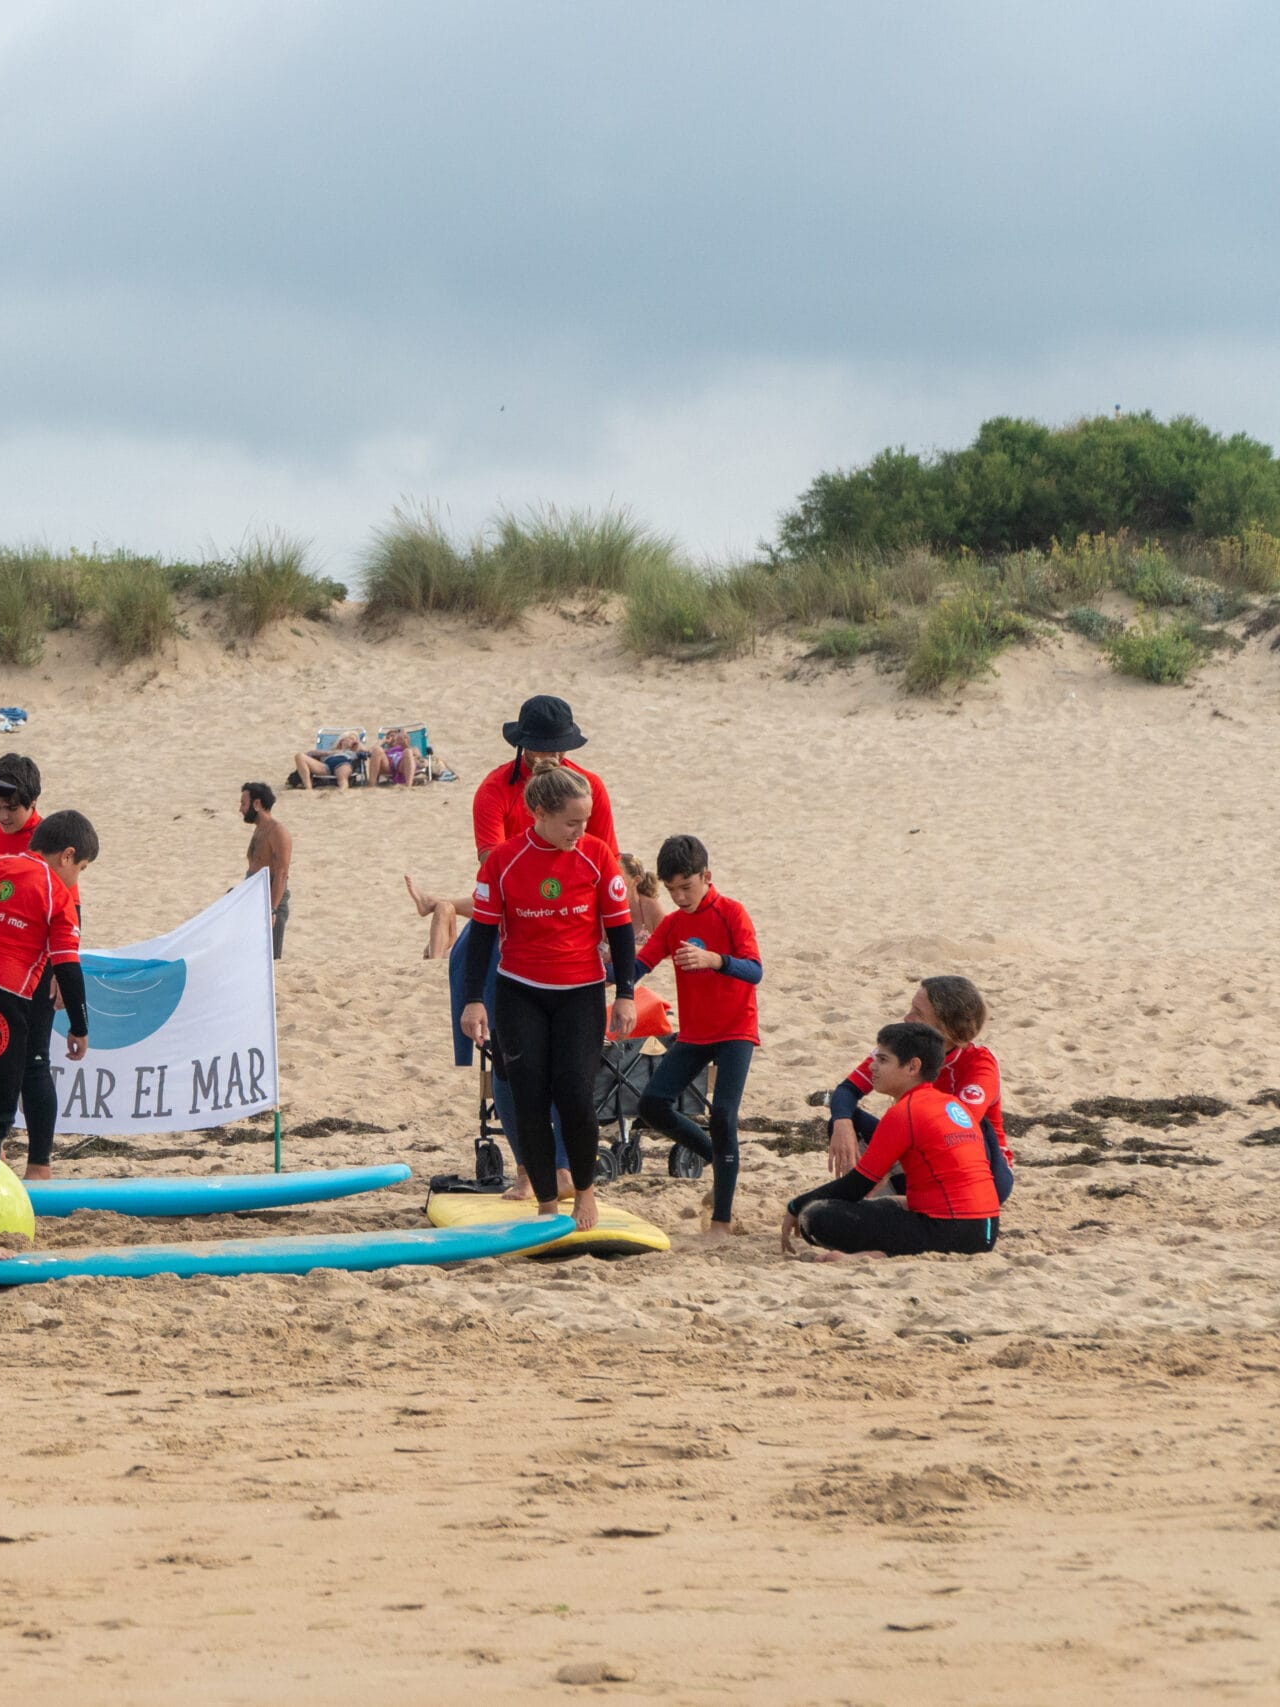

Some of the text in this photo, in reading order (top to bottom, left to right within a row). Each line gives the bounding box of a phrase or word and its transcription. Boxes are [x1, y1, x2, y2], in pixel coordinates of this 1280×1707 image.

[572, 904, 589, 915] mar
[7, 917, 28, 929] mar
[131, 1065, 172, 1118] EL
[189, 1048, 268, 1114] MAR
